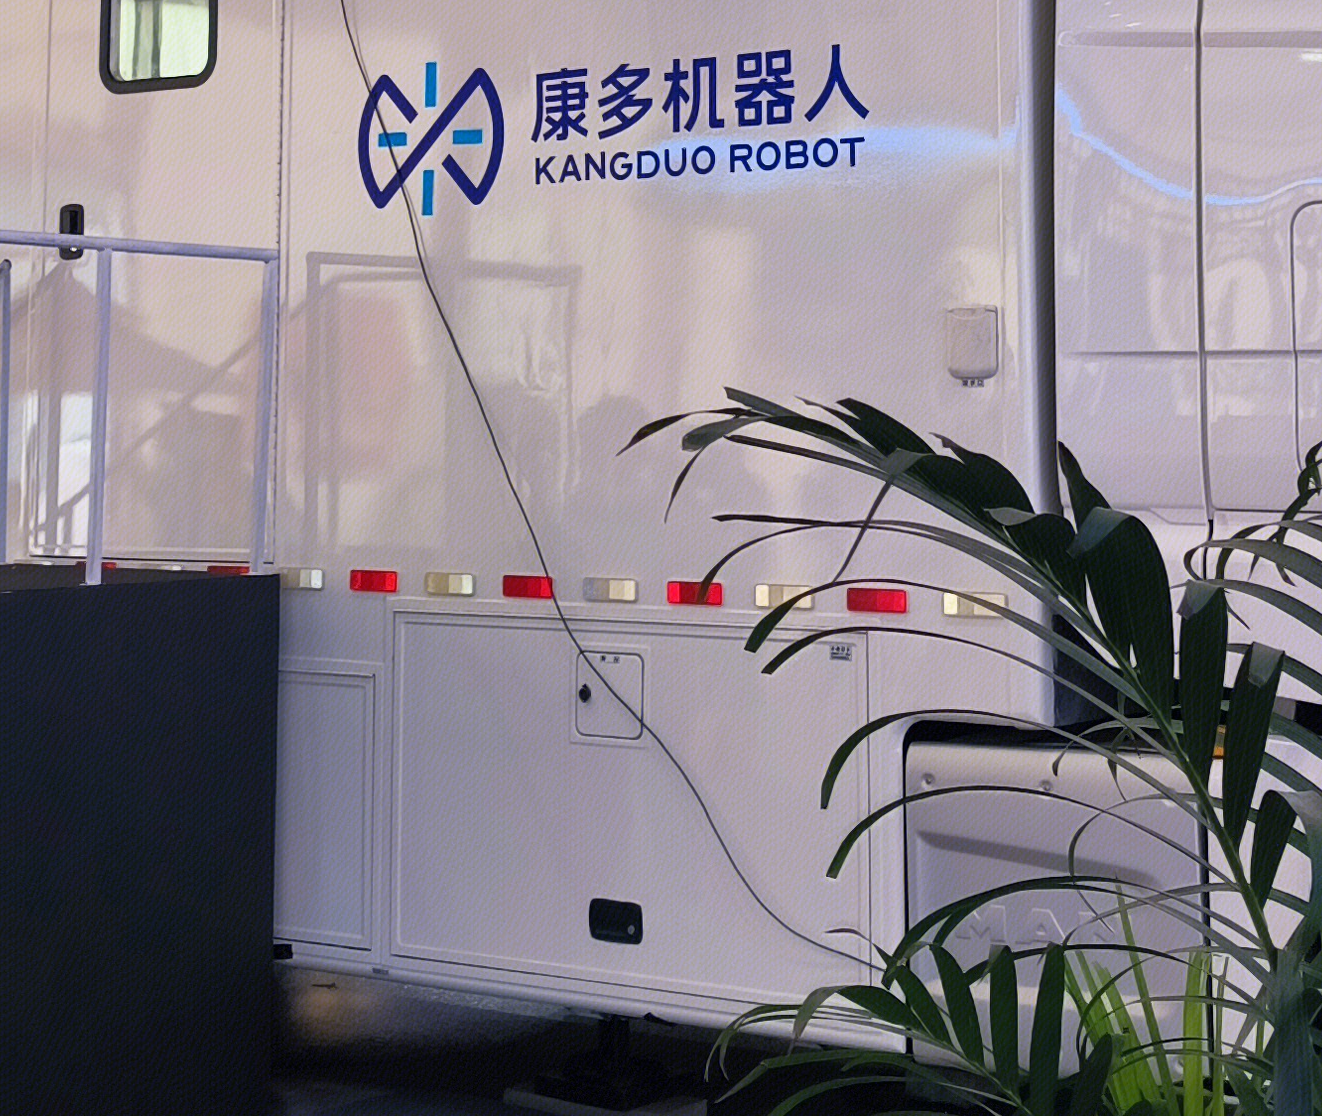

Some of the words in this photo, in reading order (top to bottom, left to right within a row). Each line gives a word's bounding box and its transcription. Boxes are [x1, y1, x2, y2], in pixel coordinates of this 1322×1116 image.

[530, 44, 870, 143] 康多机器人
[534, 145, 716, 185] KANGDUO
[729, 136, 866, 173] ROBOT
